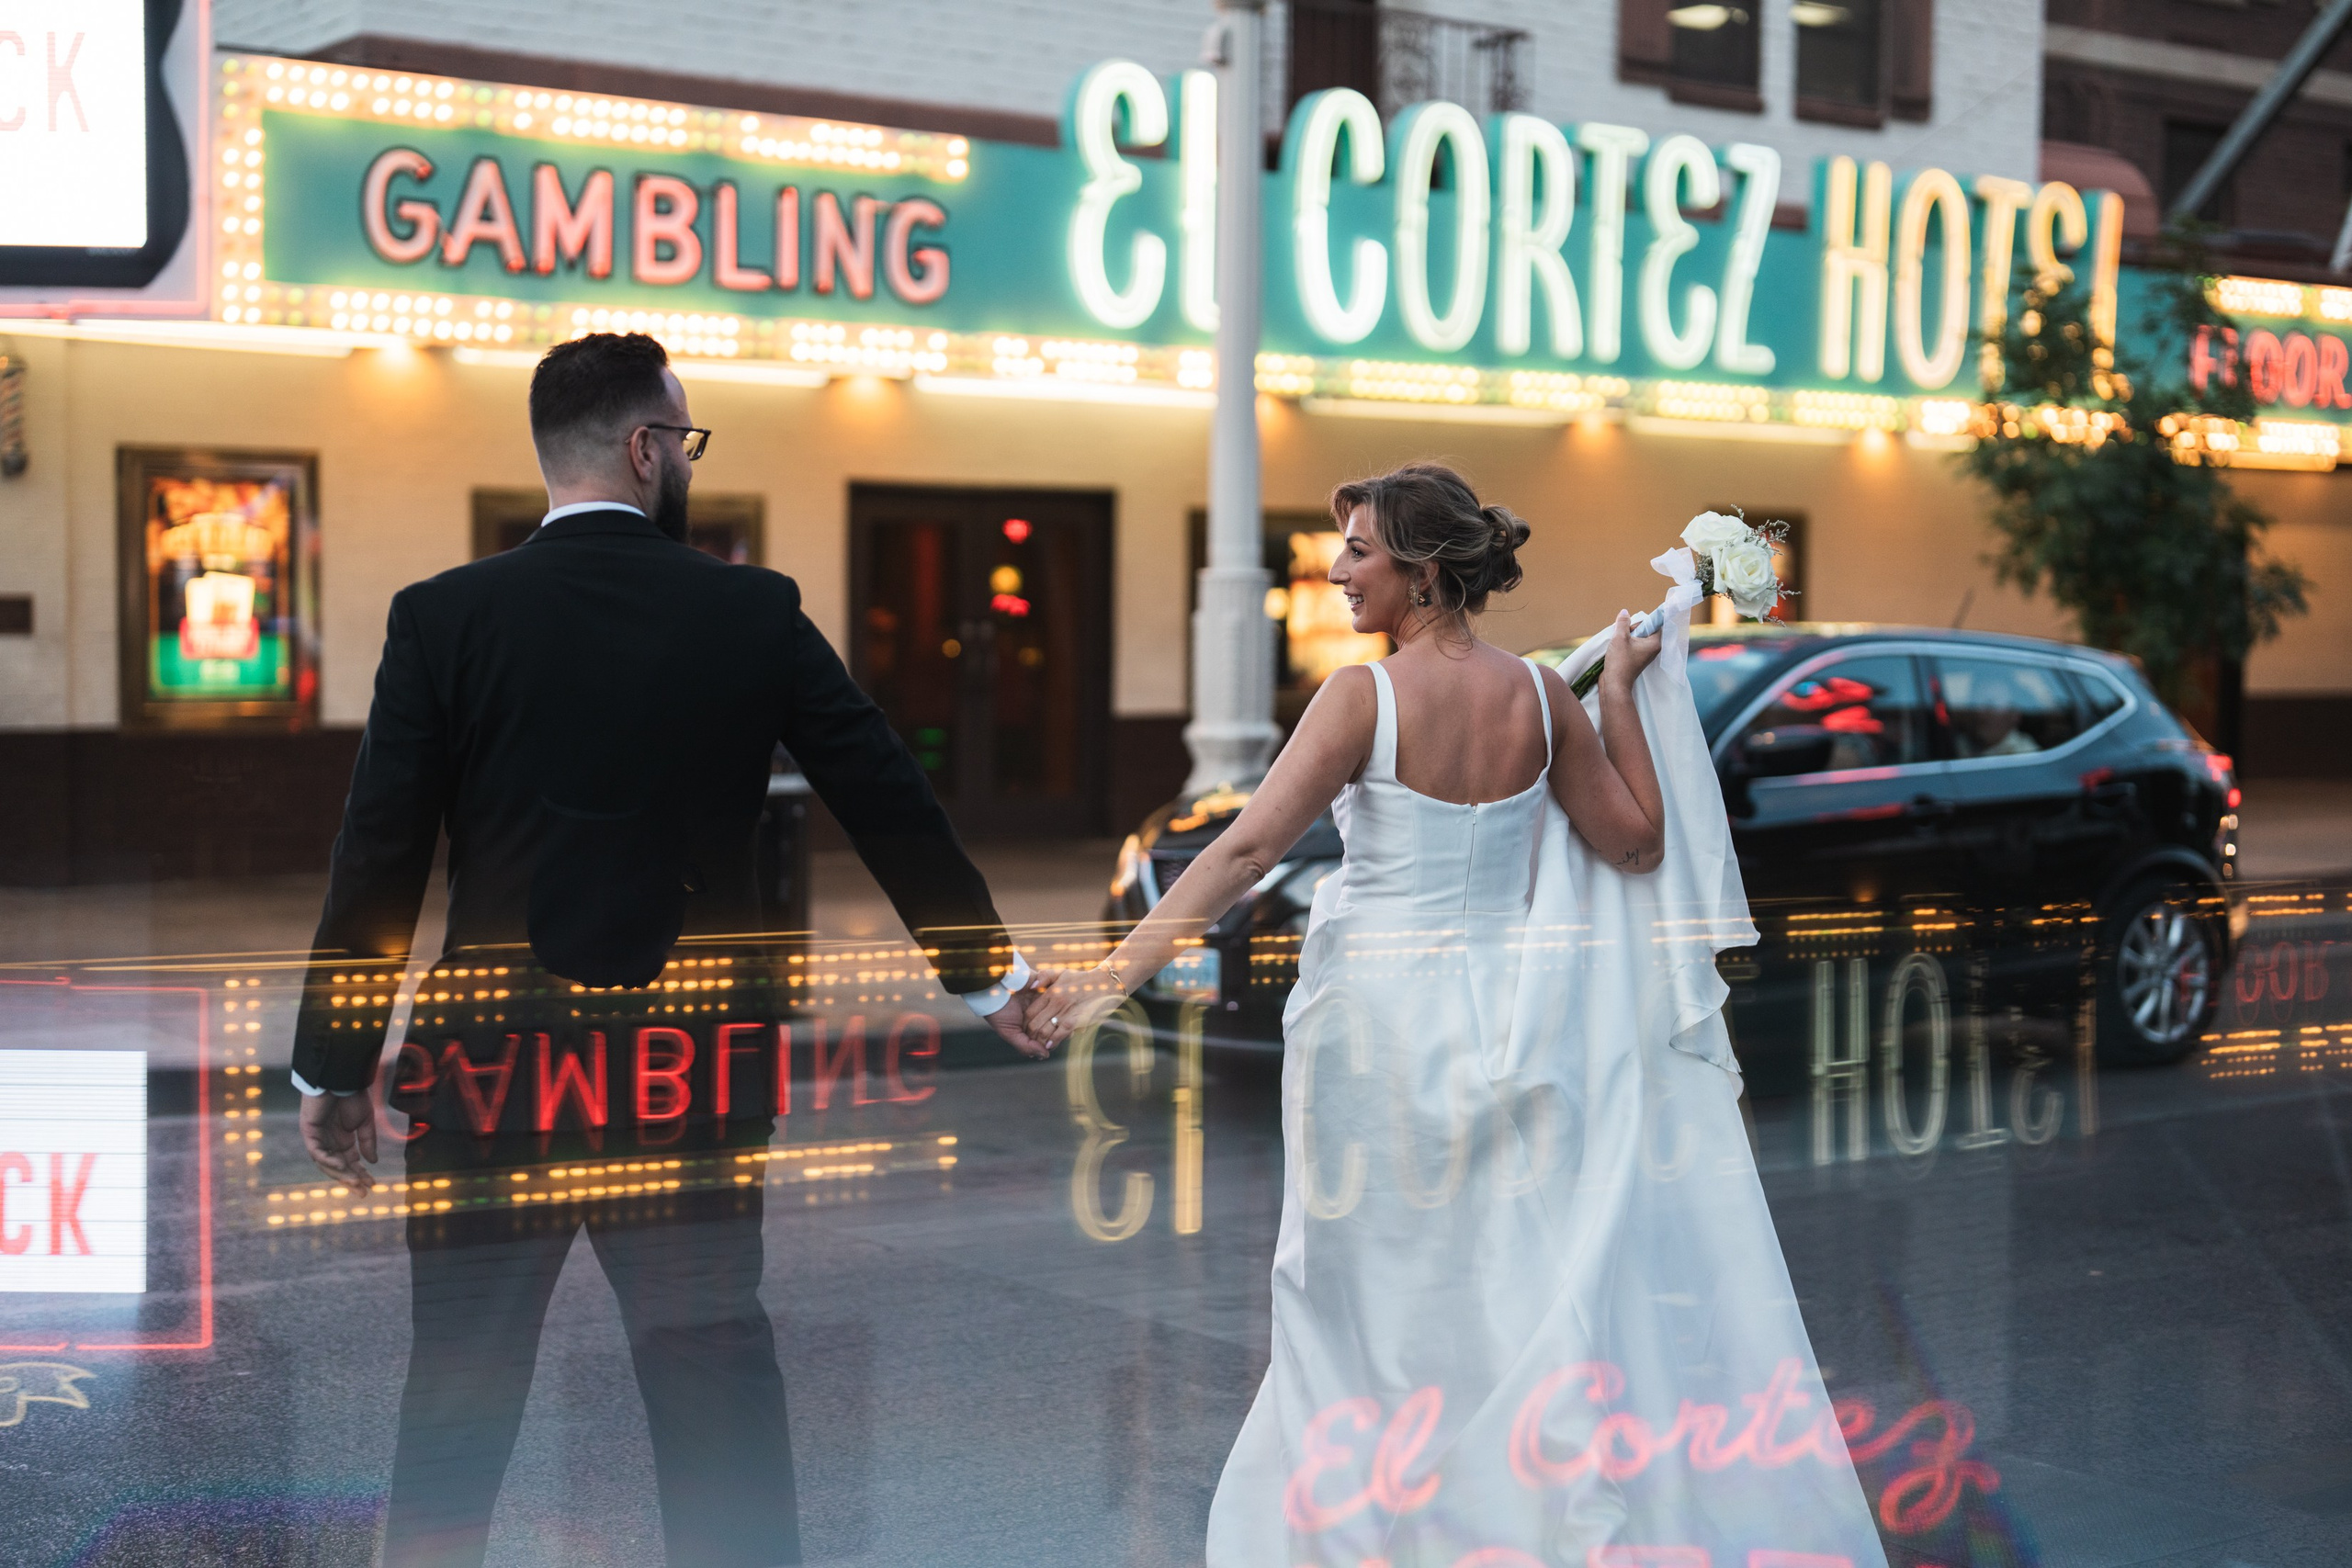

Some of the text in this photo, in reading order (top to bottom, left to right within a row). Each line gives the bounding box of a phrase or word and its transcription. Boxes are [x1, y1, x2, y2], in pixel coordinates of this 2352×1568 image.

[362, 146, 952, 304] GAMBLING
[1290, 86, 1781, 375] CORTEZ
[1282, 1358, 2003, 1537] El Cortez
